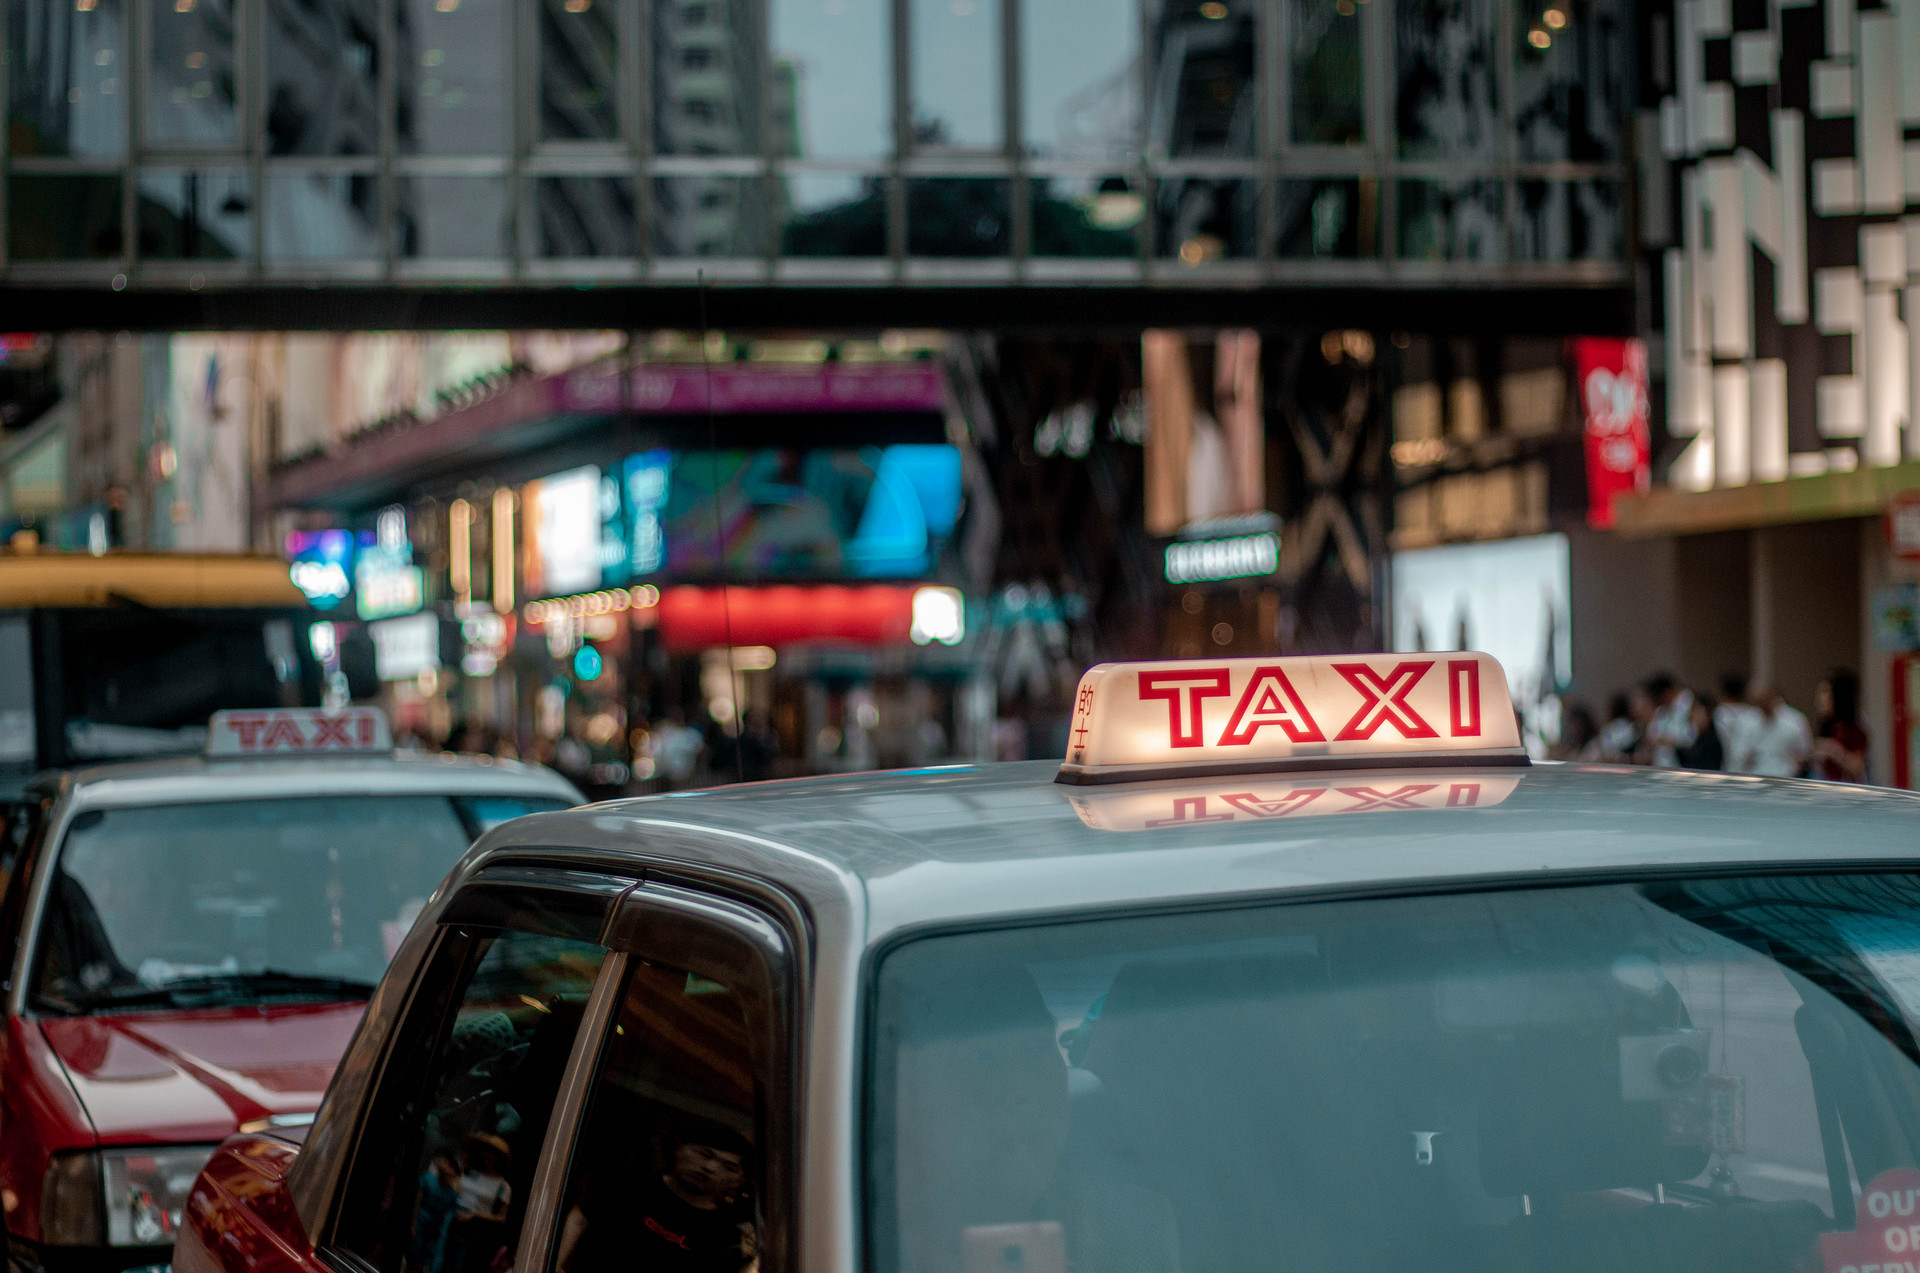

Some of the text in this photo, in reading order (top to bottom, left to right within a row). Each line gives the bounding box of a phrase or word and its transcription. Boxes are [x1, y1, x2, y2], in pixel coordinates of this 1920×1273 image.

[1074, 685, 1093, 748] 的士
[1138, 660, 1481, 748] TAXI
[227, 712, 375, 750] TAXI
[1867, 1190, 1920, 1218] OU
